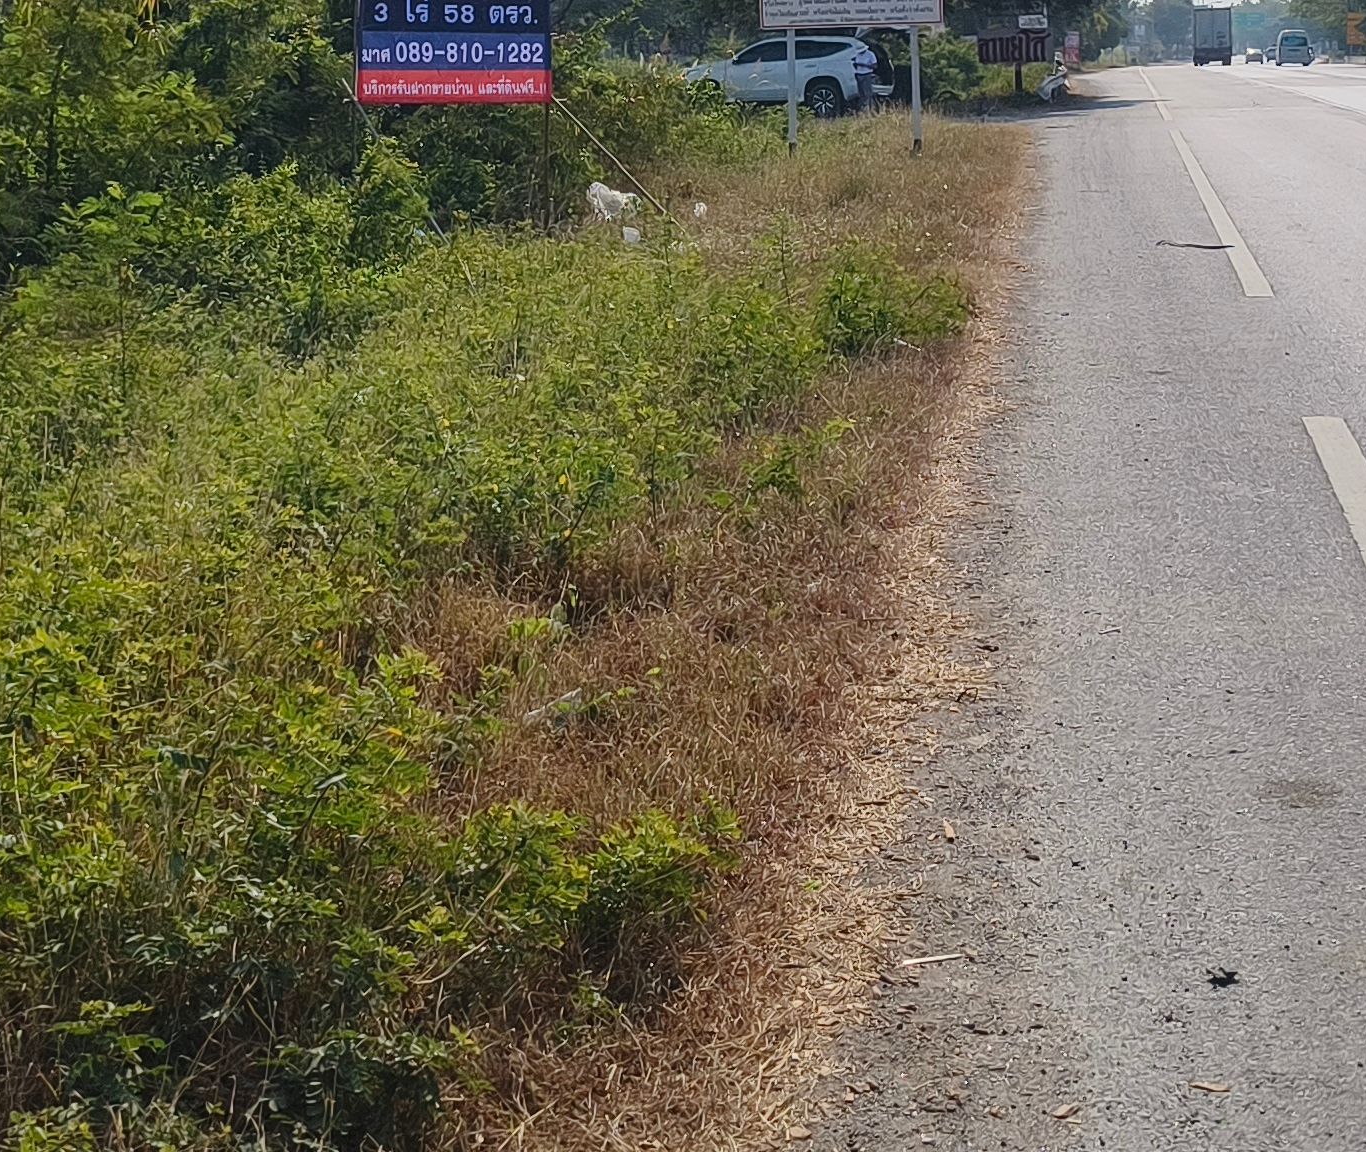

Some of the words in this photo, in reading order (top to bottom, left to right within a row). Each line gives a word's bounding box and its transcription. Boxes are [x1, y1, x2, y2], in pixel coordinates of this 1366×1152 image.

[374, 2, 388, 22] 3
[444, 4, 475, 24] 58
[489, 4, 538, 24] ตรว.
[361, 48, 390, 63] มาศ
[395, 41, 544, 63] 089-810-1282
